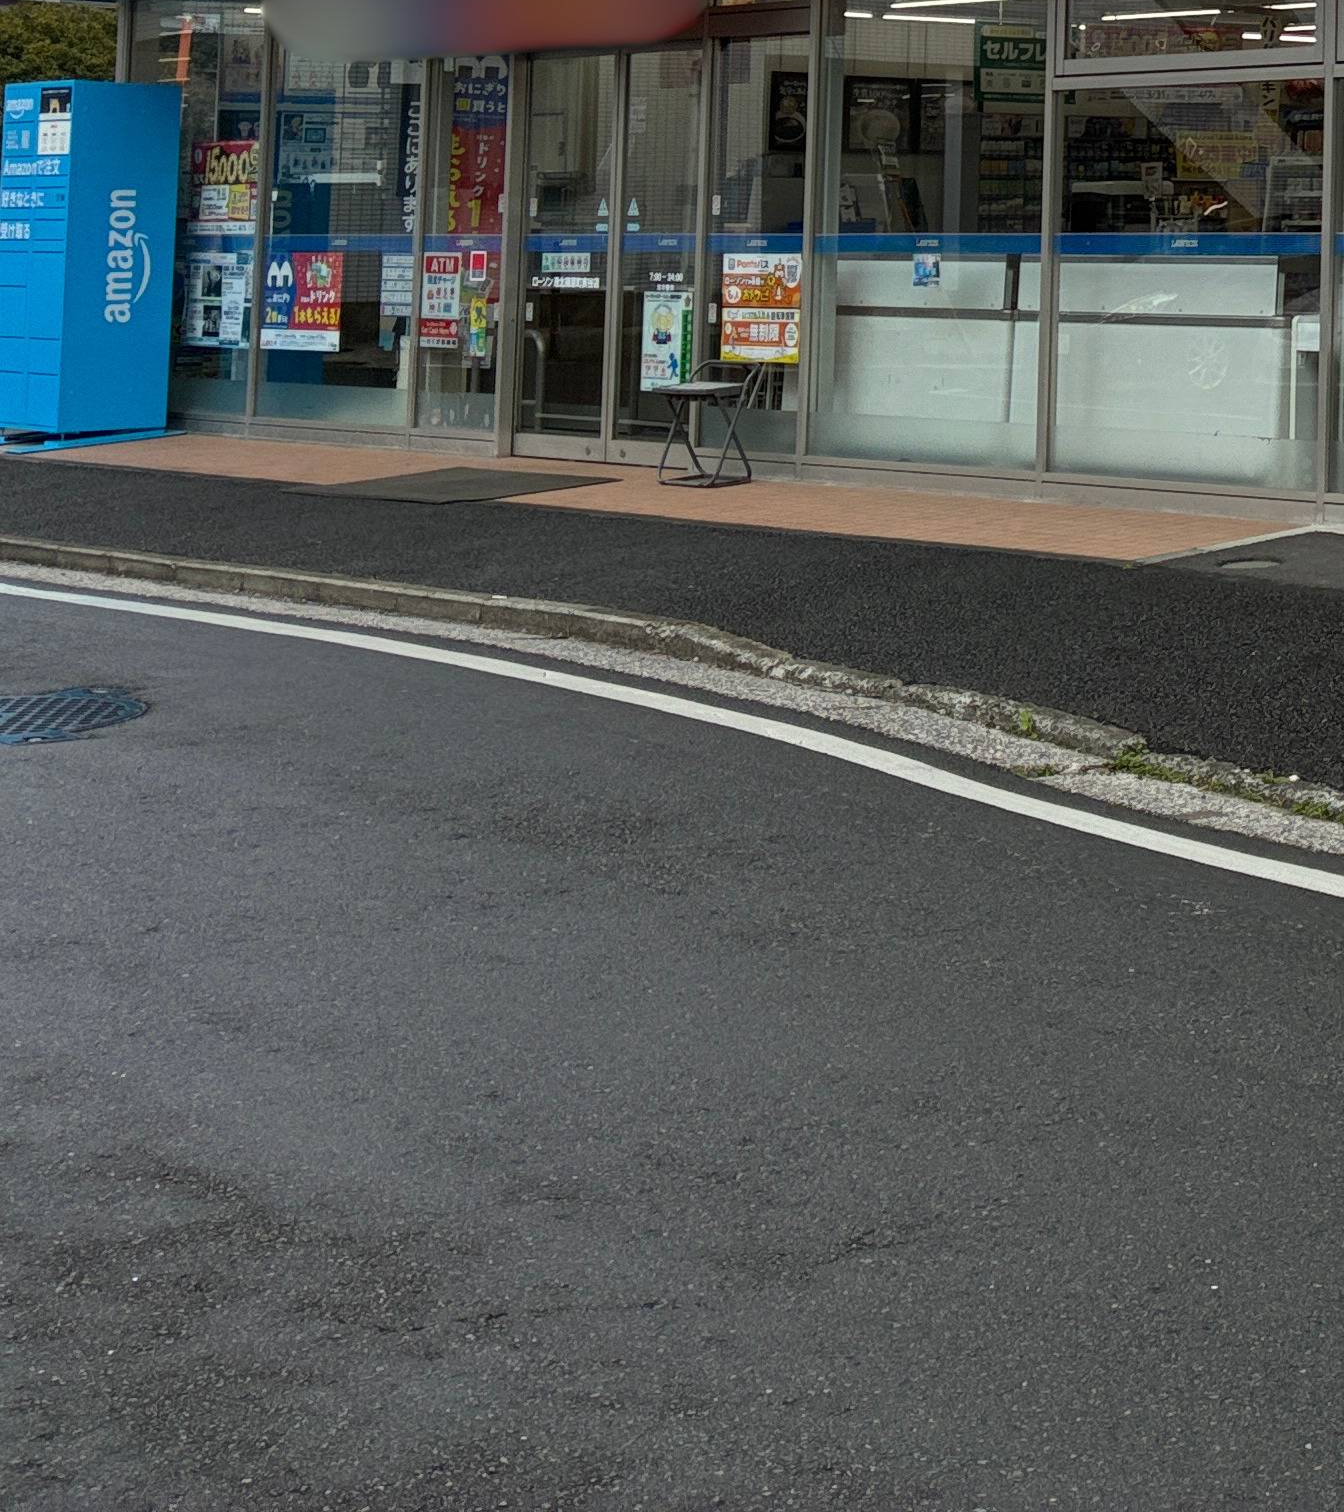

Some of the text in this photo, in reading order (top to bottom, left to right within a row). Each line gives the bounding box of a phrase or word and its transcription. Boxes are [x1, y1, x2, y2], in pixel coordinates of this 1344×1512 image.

[3, 159, 61, 176] Amazonで注文
[104, 189, 137, 324] amazon
[430, 258, 454, 272] ATM
